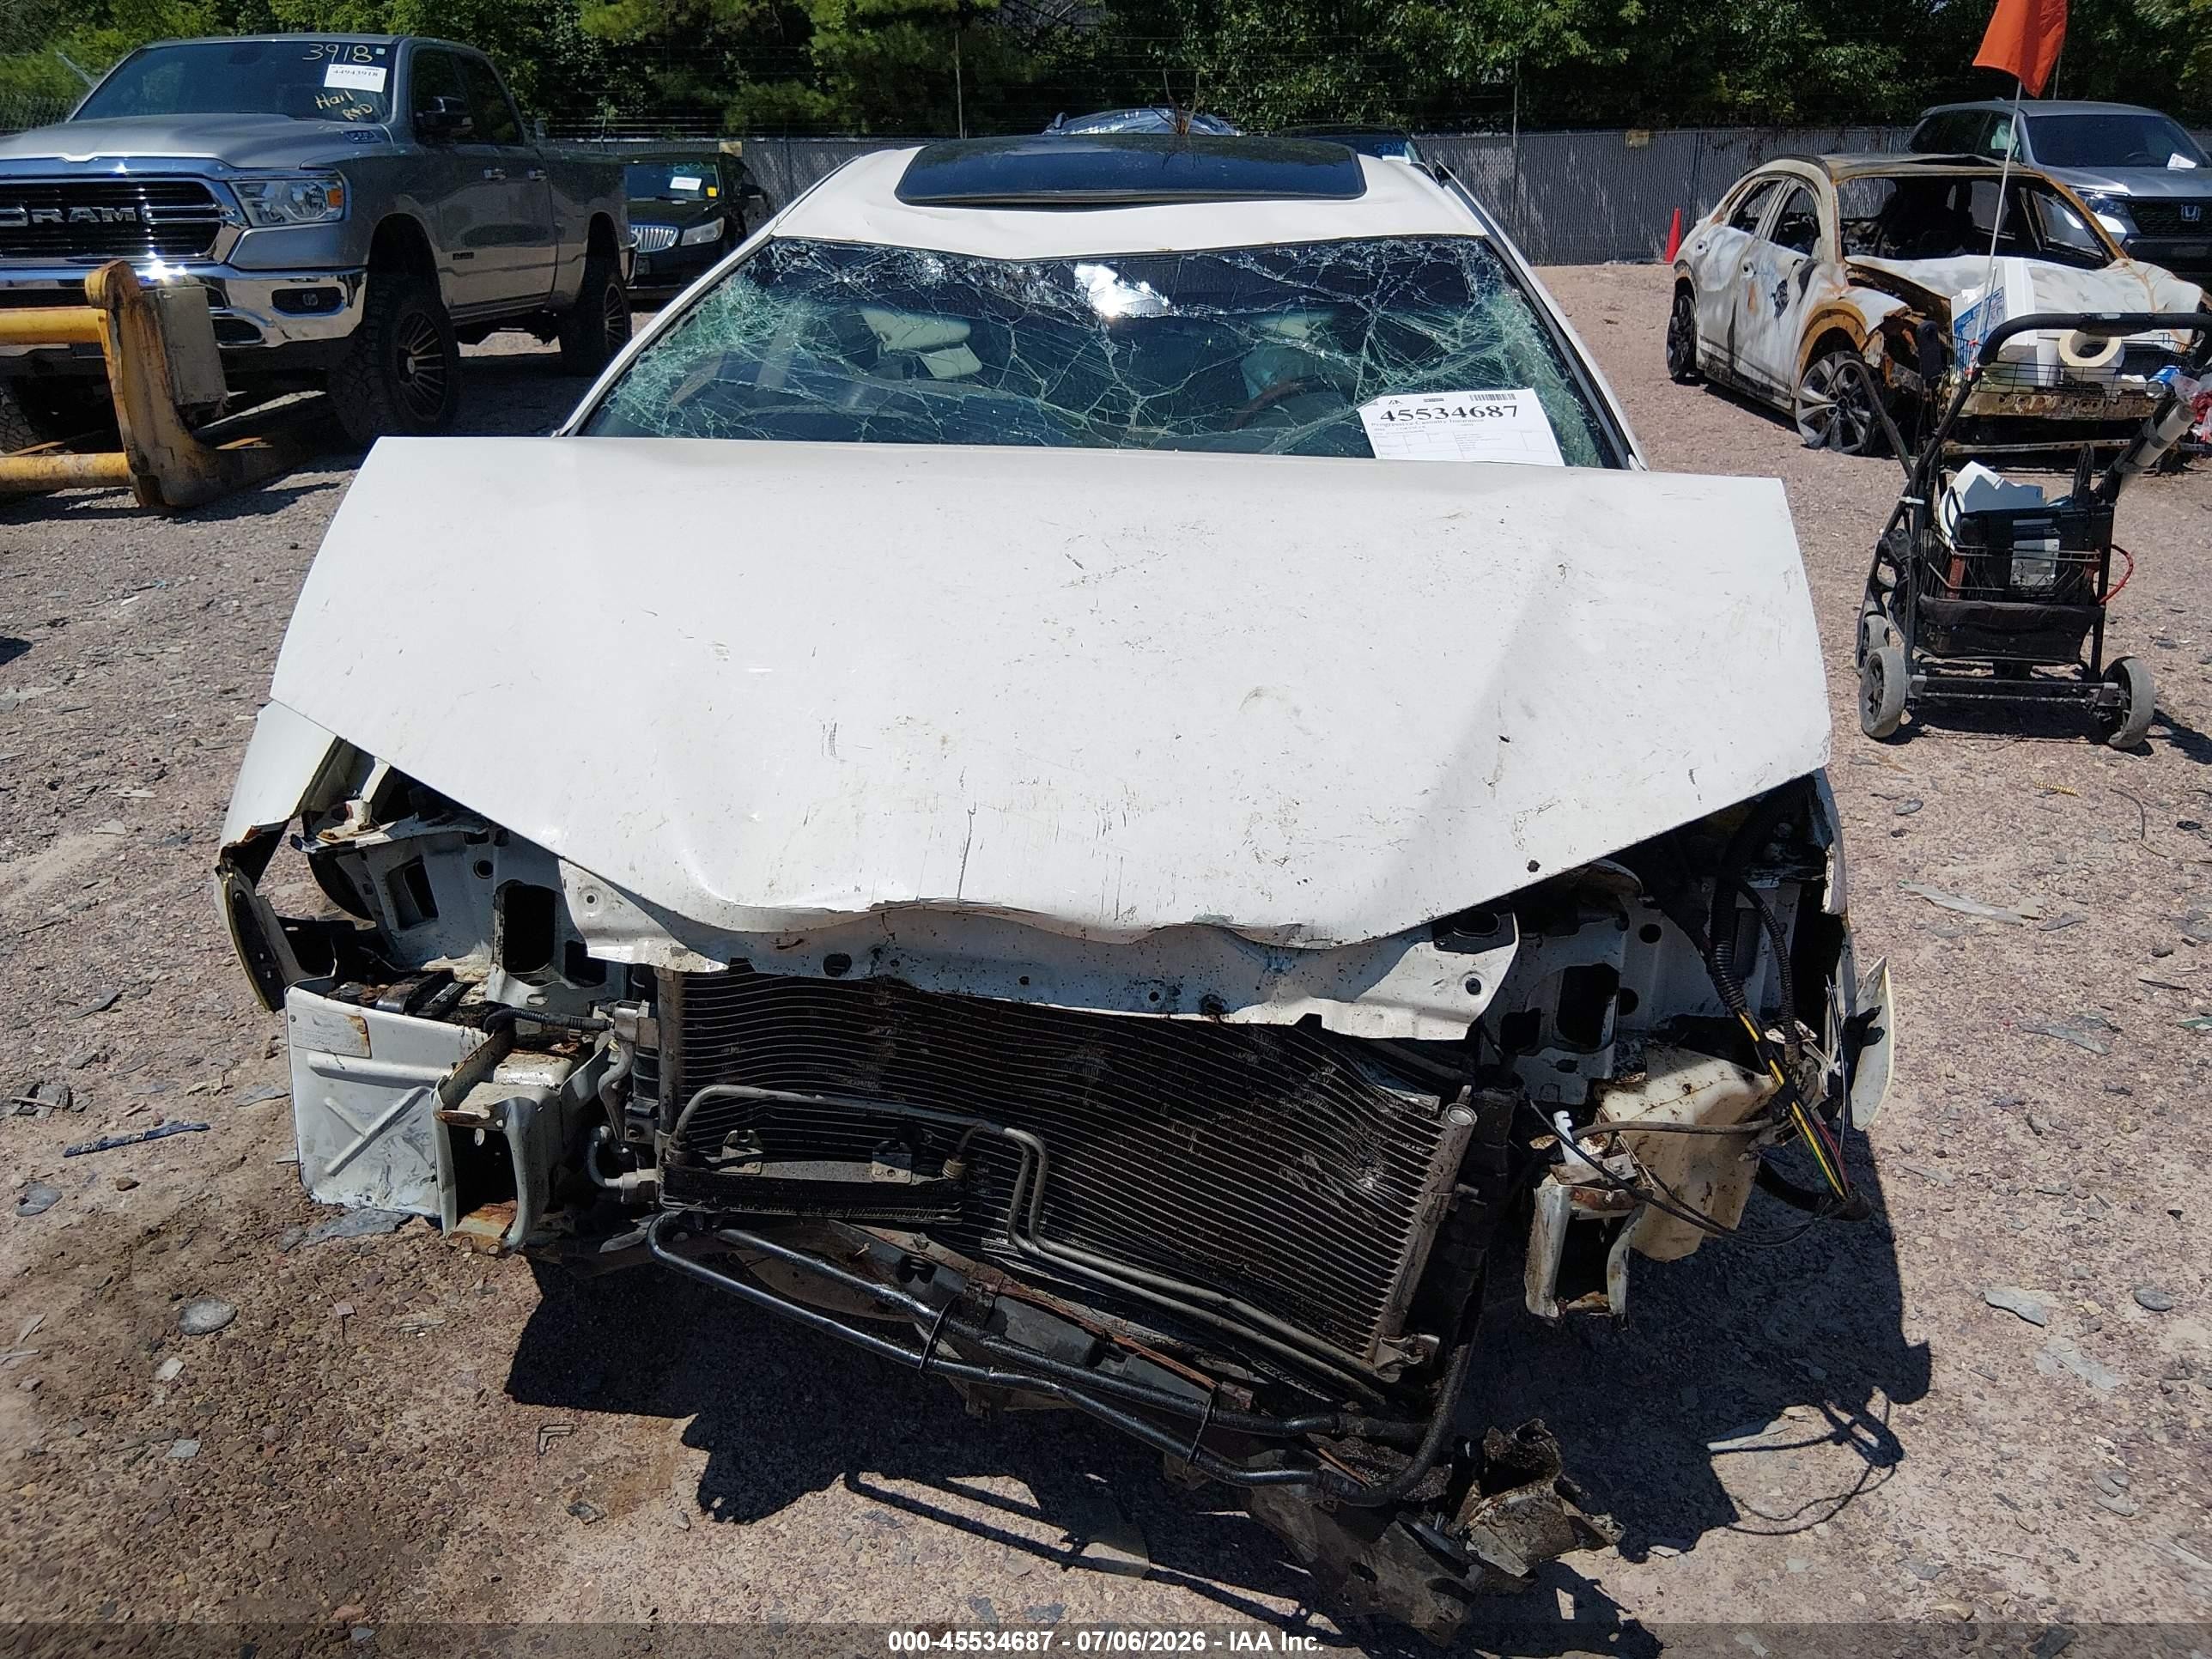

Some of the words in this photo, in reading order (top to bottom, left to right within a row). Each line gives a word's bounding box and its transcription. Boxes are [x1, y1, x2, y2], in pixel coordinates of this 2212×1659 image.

[302, 44, 373, 63] 3918
[314, 89, 354, 109] Hail
[31, 207, 137, 223] RAM
[1380, 404, 1518, 422] 45534687
